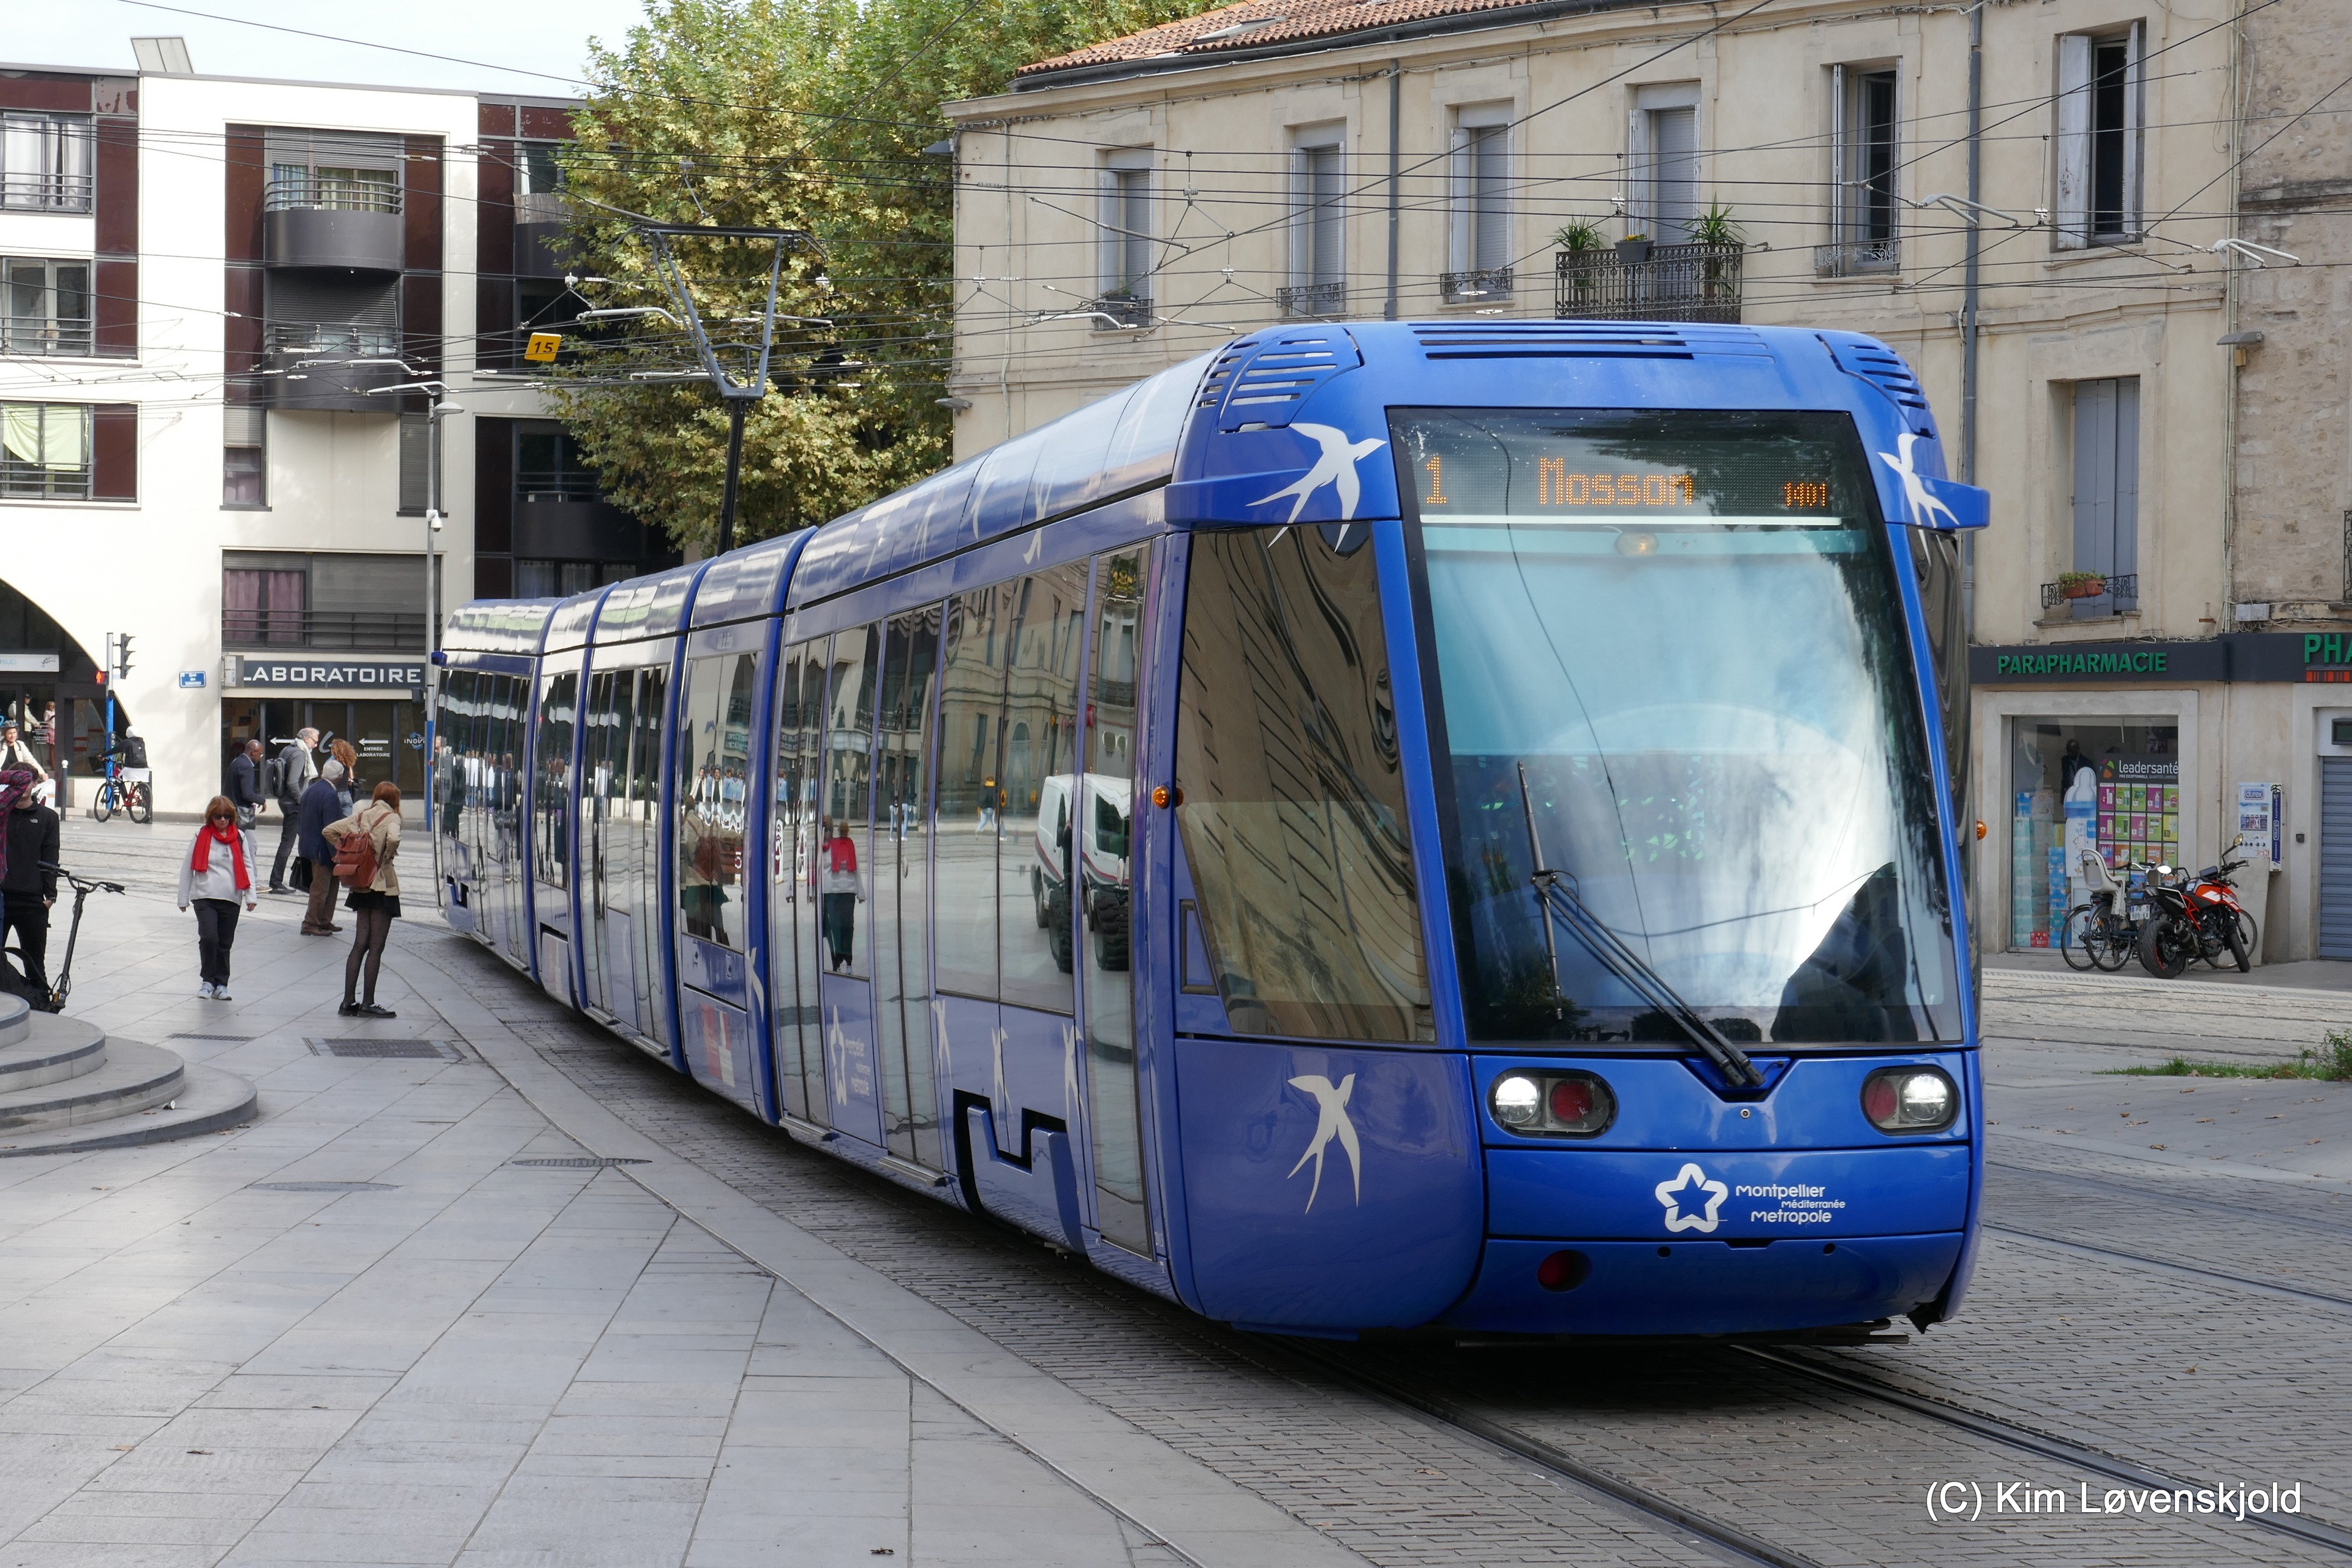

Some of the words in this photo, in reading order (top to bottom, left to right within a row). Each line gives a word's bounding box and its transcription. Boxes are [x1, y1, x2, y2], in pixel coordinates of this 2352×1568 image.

[535, 342, 553, 353] 15
[1425, 456, 1447, 504] 1
[1539, 456, 1694, 506] Mosson
[1997, 652, 2167, 674] PARAPHARMACIE
[2245, 790, 2263, 799] durex
[1736, 1183, 1825, 1200] Montpellier
[1781, 1199, 1845, 1209] Méditerranée
[1751, 1209, 1832, 1225] Metropole
